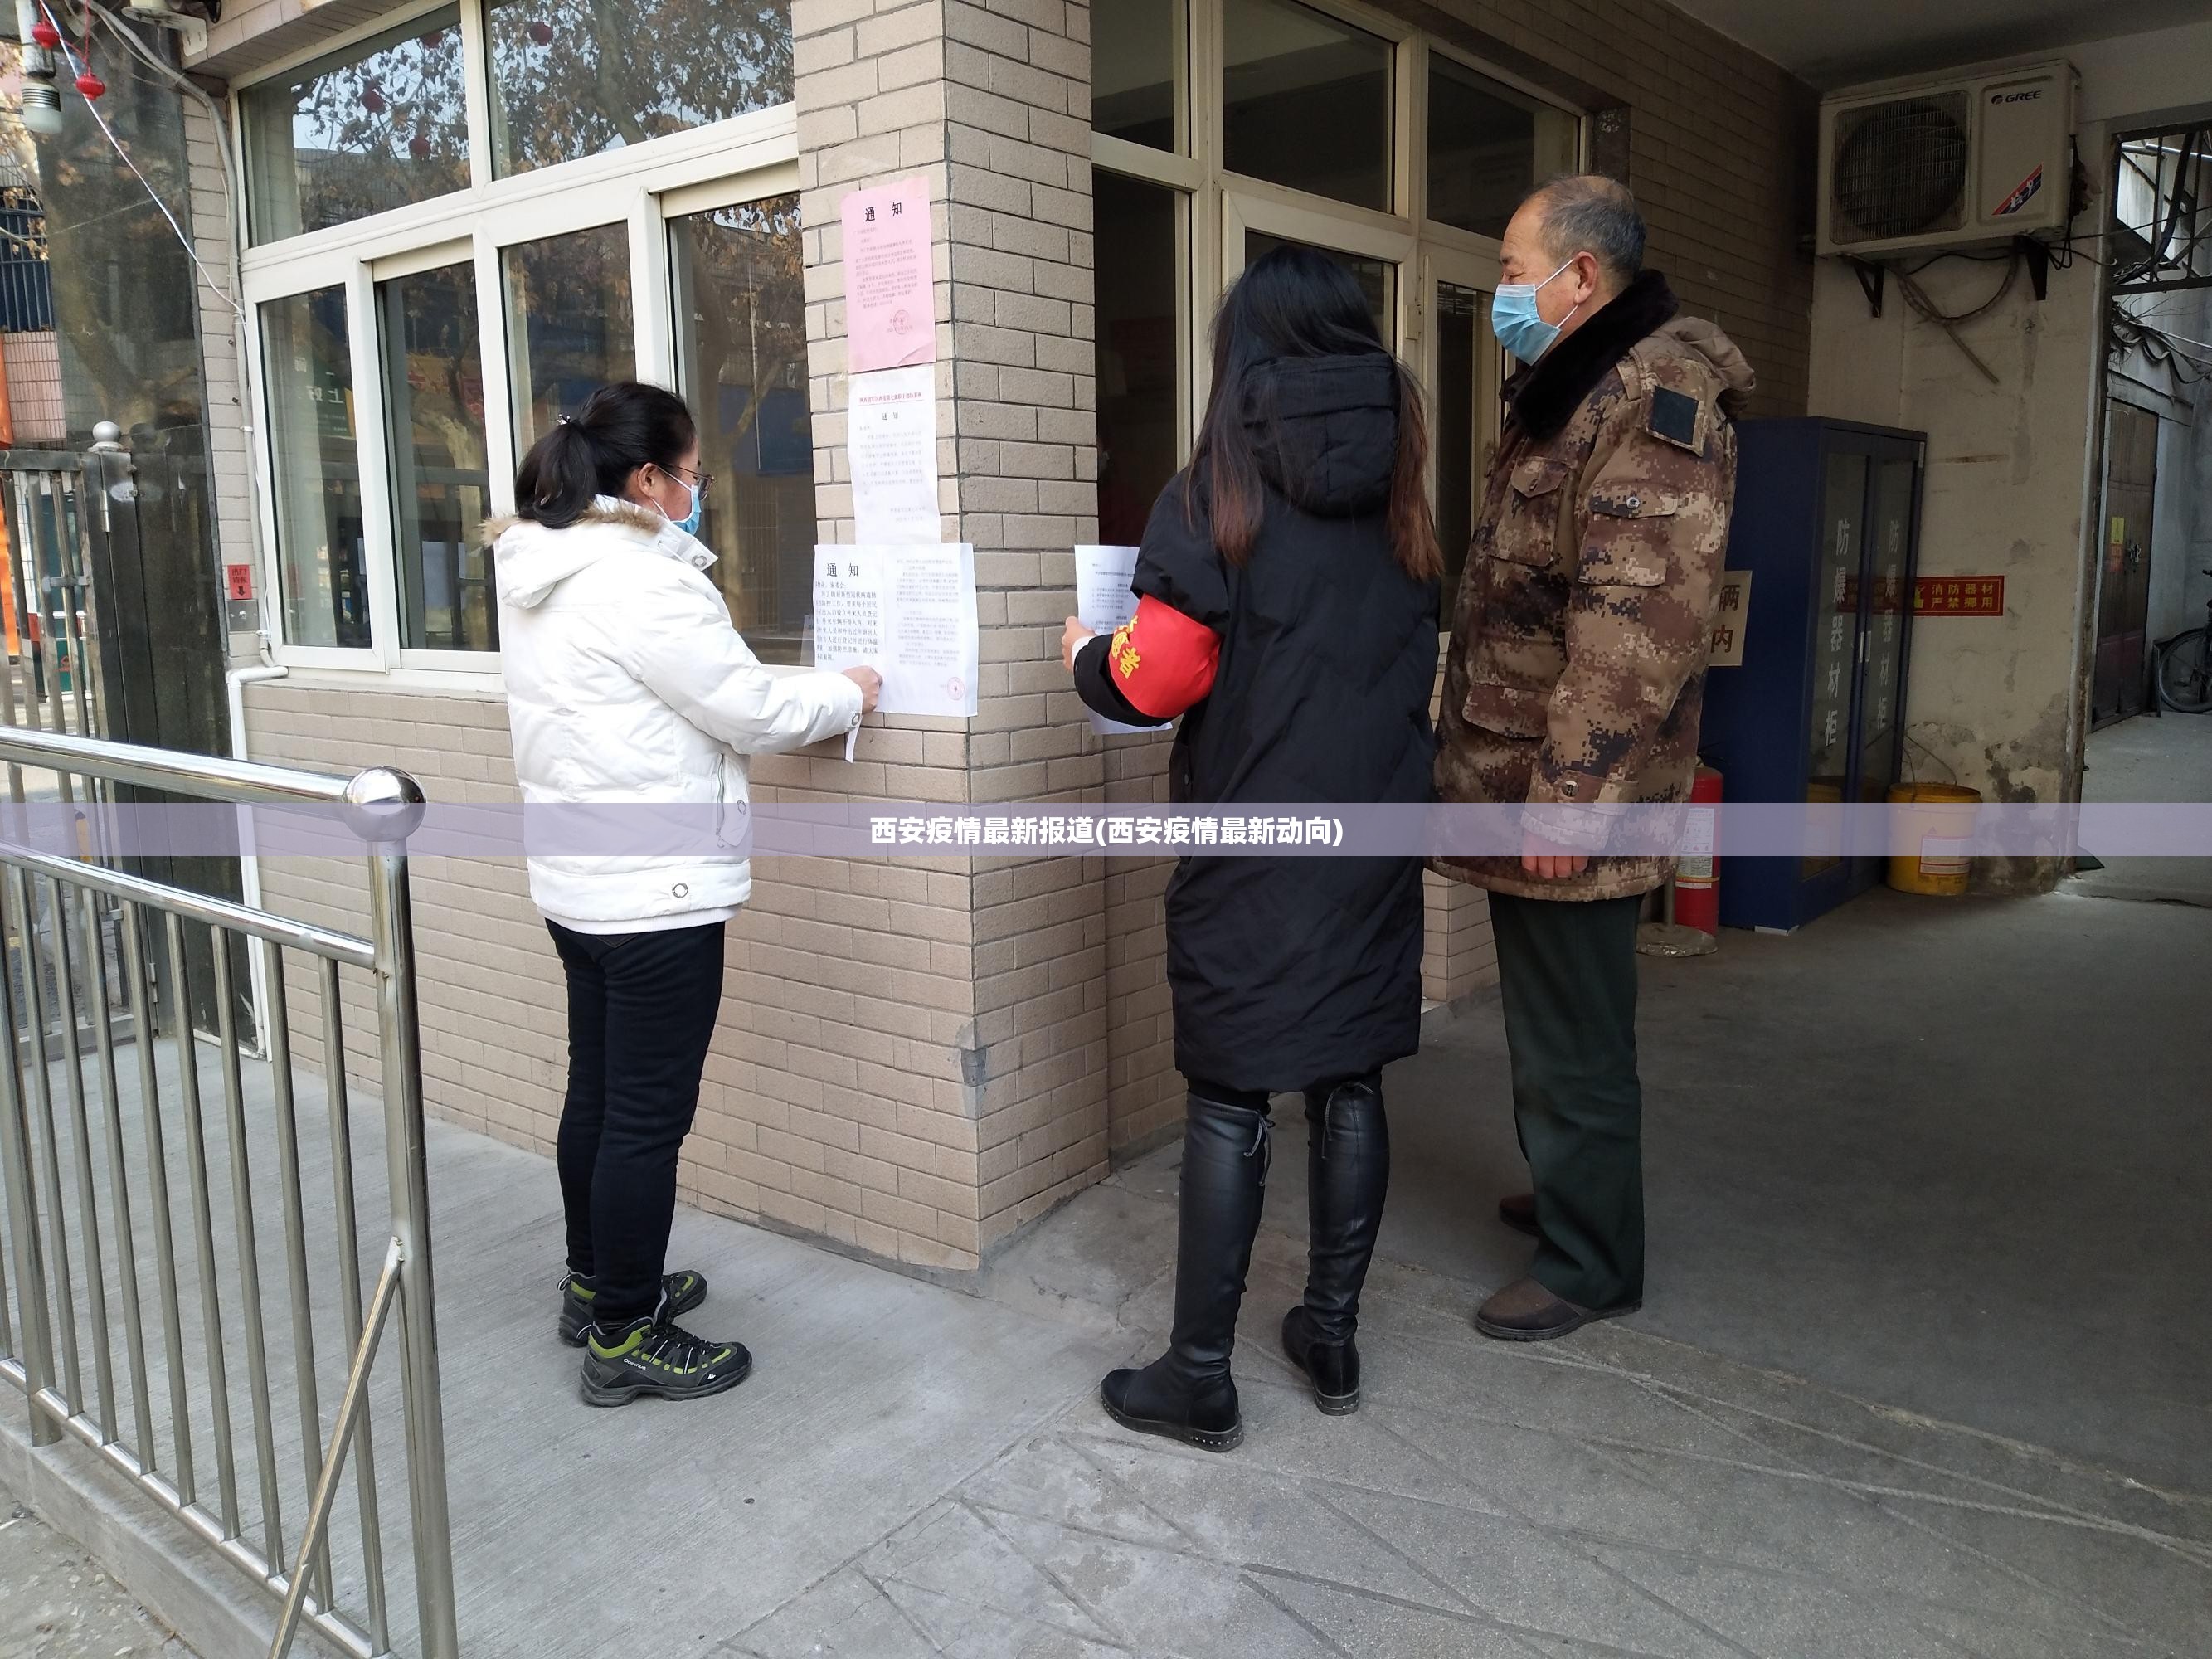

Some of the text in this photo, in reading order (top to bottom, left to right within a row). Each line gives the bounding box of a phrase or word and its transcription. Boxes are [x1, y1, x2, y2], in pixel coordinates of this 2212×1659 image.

[2005, 90, 2041, 102] GREE
[865, 202, 902, 222] 通知
[826, 562, 858, 577] 通知
[1931, 583, 1994, 595] 消防器材
[1931, 596, 1994, 609] 严禁挪用
[1710, 624, 1733, 653] 内
[624, 1358, 646, 1370] Quechua
